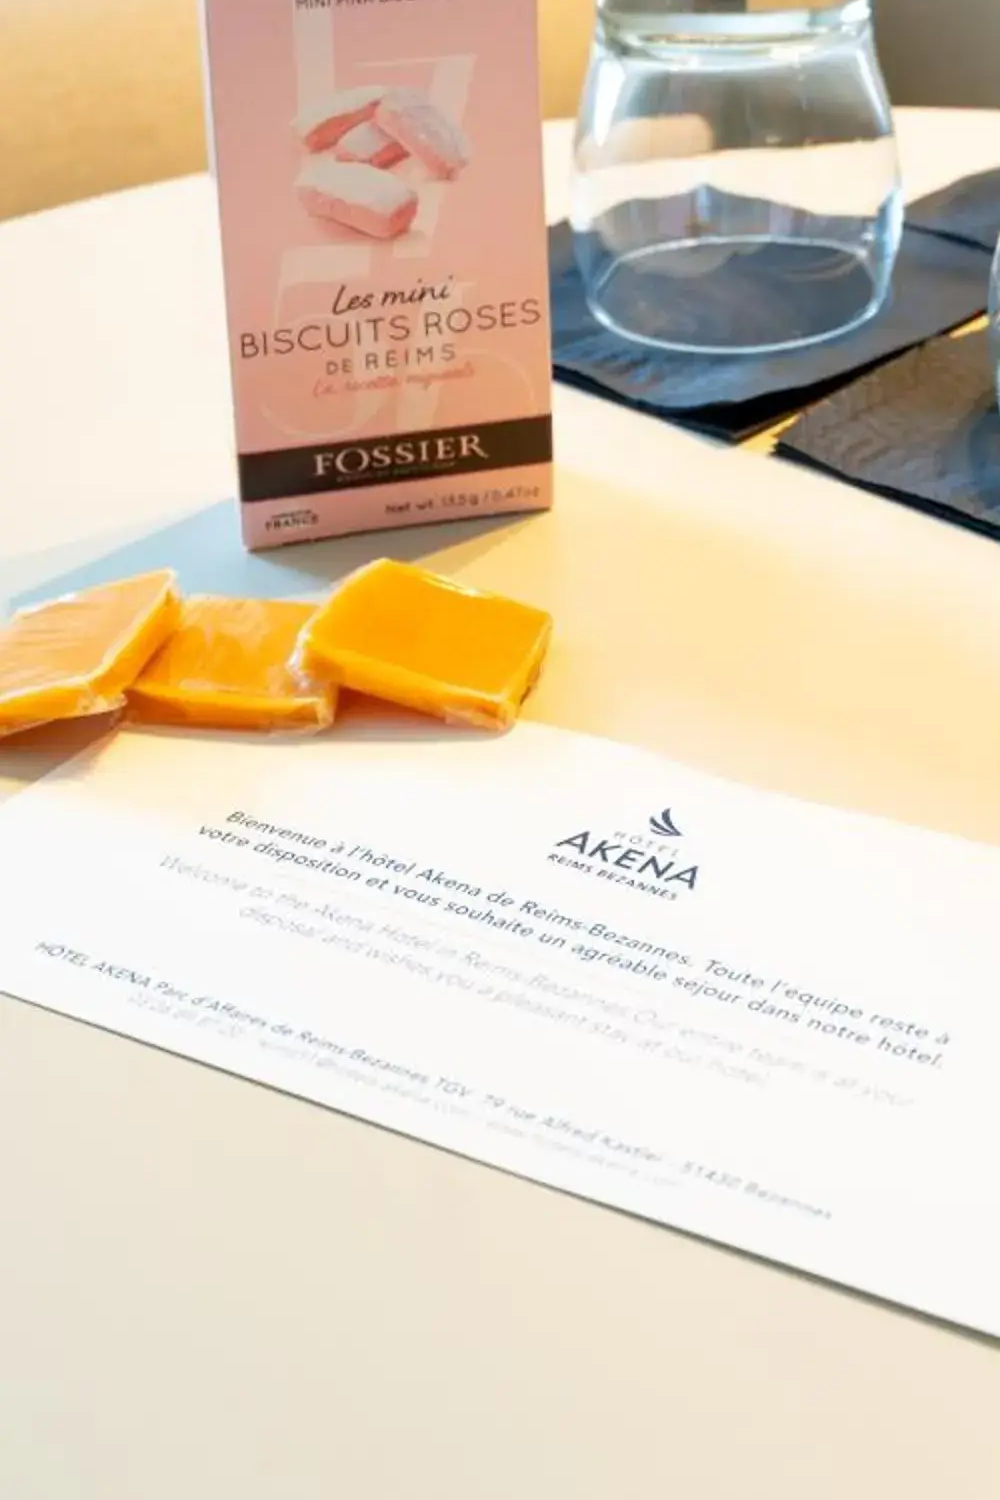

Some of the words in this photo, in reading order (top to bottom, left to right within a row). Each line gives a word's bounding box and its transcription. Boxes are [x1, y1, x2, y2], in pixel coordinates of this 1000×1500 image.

[331, 283, 373, 316] Les
[382, 274, 454, 304] mini
[240, 314, 411, 360] BISCUITS
[423, 298, 542, 338] ROSES
[325, 359, 354, 376] DE
[364, 342, 457, 371] REIMS
[313, 434, 490, 477] FOSSIER
[547, 853, 594, 874] REIMS
[596, 868, 678, 901] BEZANNES
[555, 830, 699, 891] AKENA
[198, 824, 251, 847] votre
[252, 840, 362, 882] disposition
[364, 874, 390, 891] et
[392, 884, 440, 908] vous
[442, 900, 534, 937] souhaite
[537, 932, 567, 950] un
[746, 997, 801, 1024] dans
[806, 1016, 871, 1045] notre
[225, 810, 327, 849] Bienvenue
[330, 839, 346, 854] à
[346, 844, 417, 875] l'hôtel
[416, 867, 483, 897] Akena
[485, 890, 515, 907] de
[704, 958, 765, 988] Toute
[869, 1014, 930, 1040] reste
[89, 960, 151, 989] AKENA
